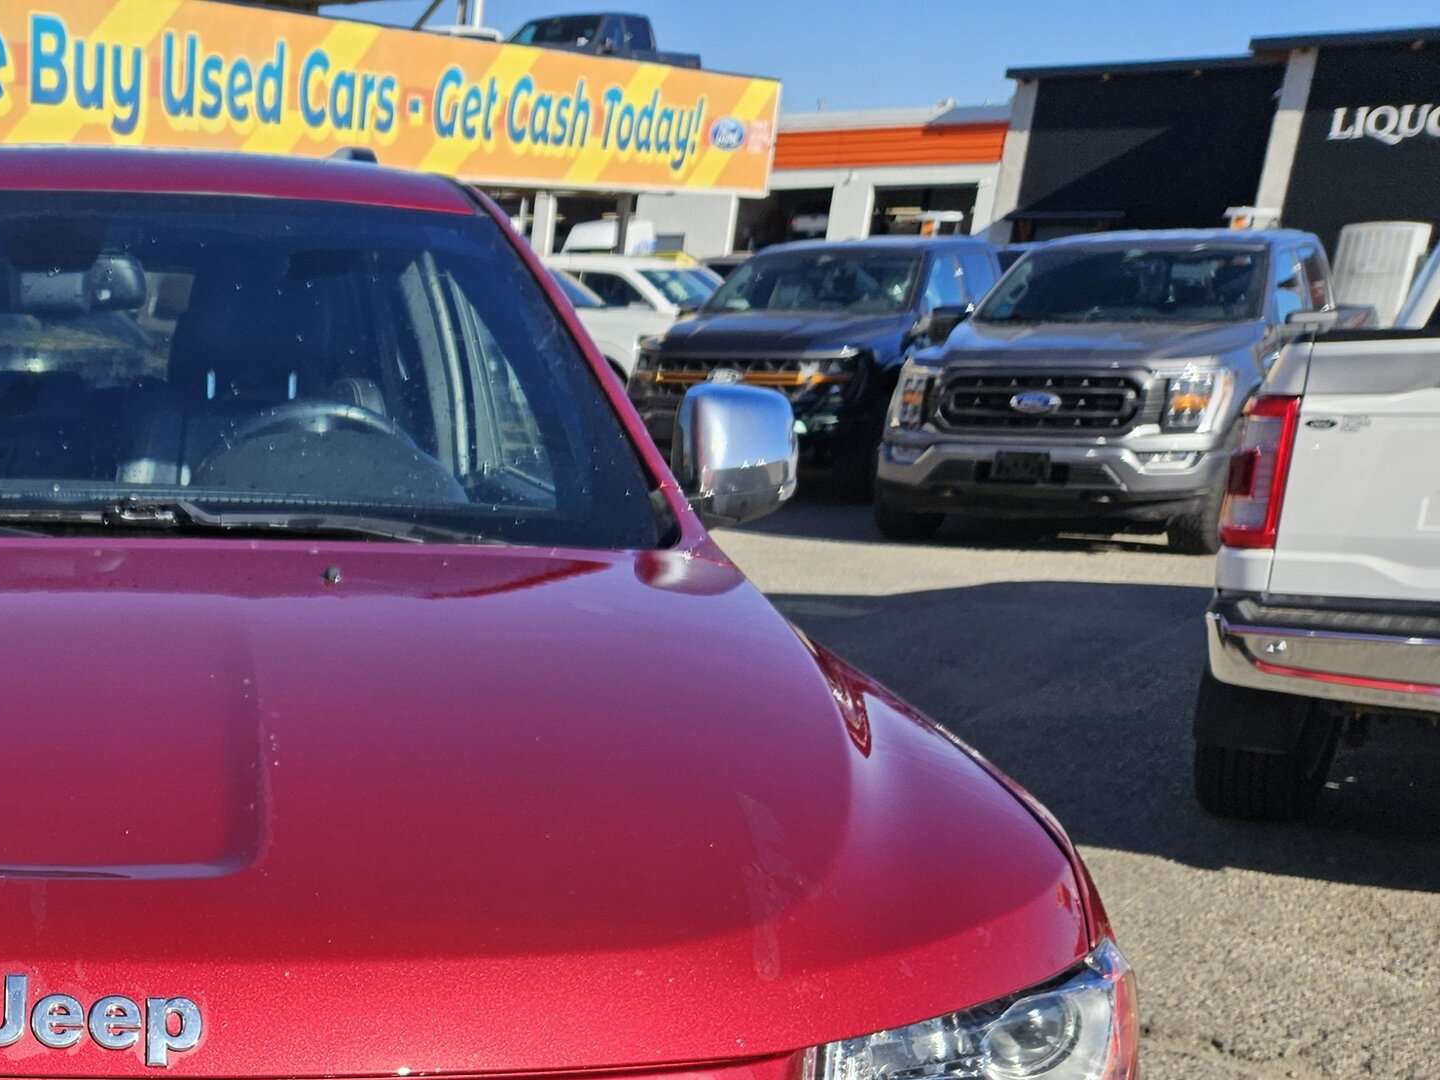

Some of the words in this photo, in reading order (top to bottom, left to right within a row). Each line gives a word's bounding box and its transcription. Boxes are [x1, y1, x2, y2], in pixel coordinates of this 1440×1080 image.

[30, 14, 142, 135] Buy
[163, 32, 286, 124] Used
[300, 49, 396, 133] Cars
[434, 67, 497, 141] Get
[507, 77, 590, 148] Cash
[602, 87, 704, 170] Today!
